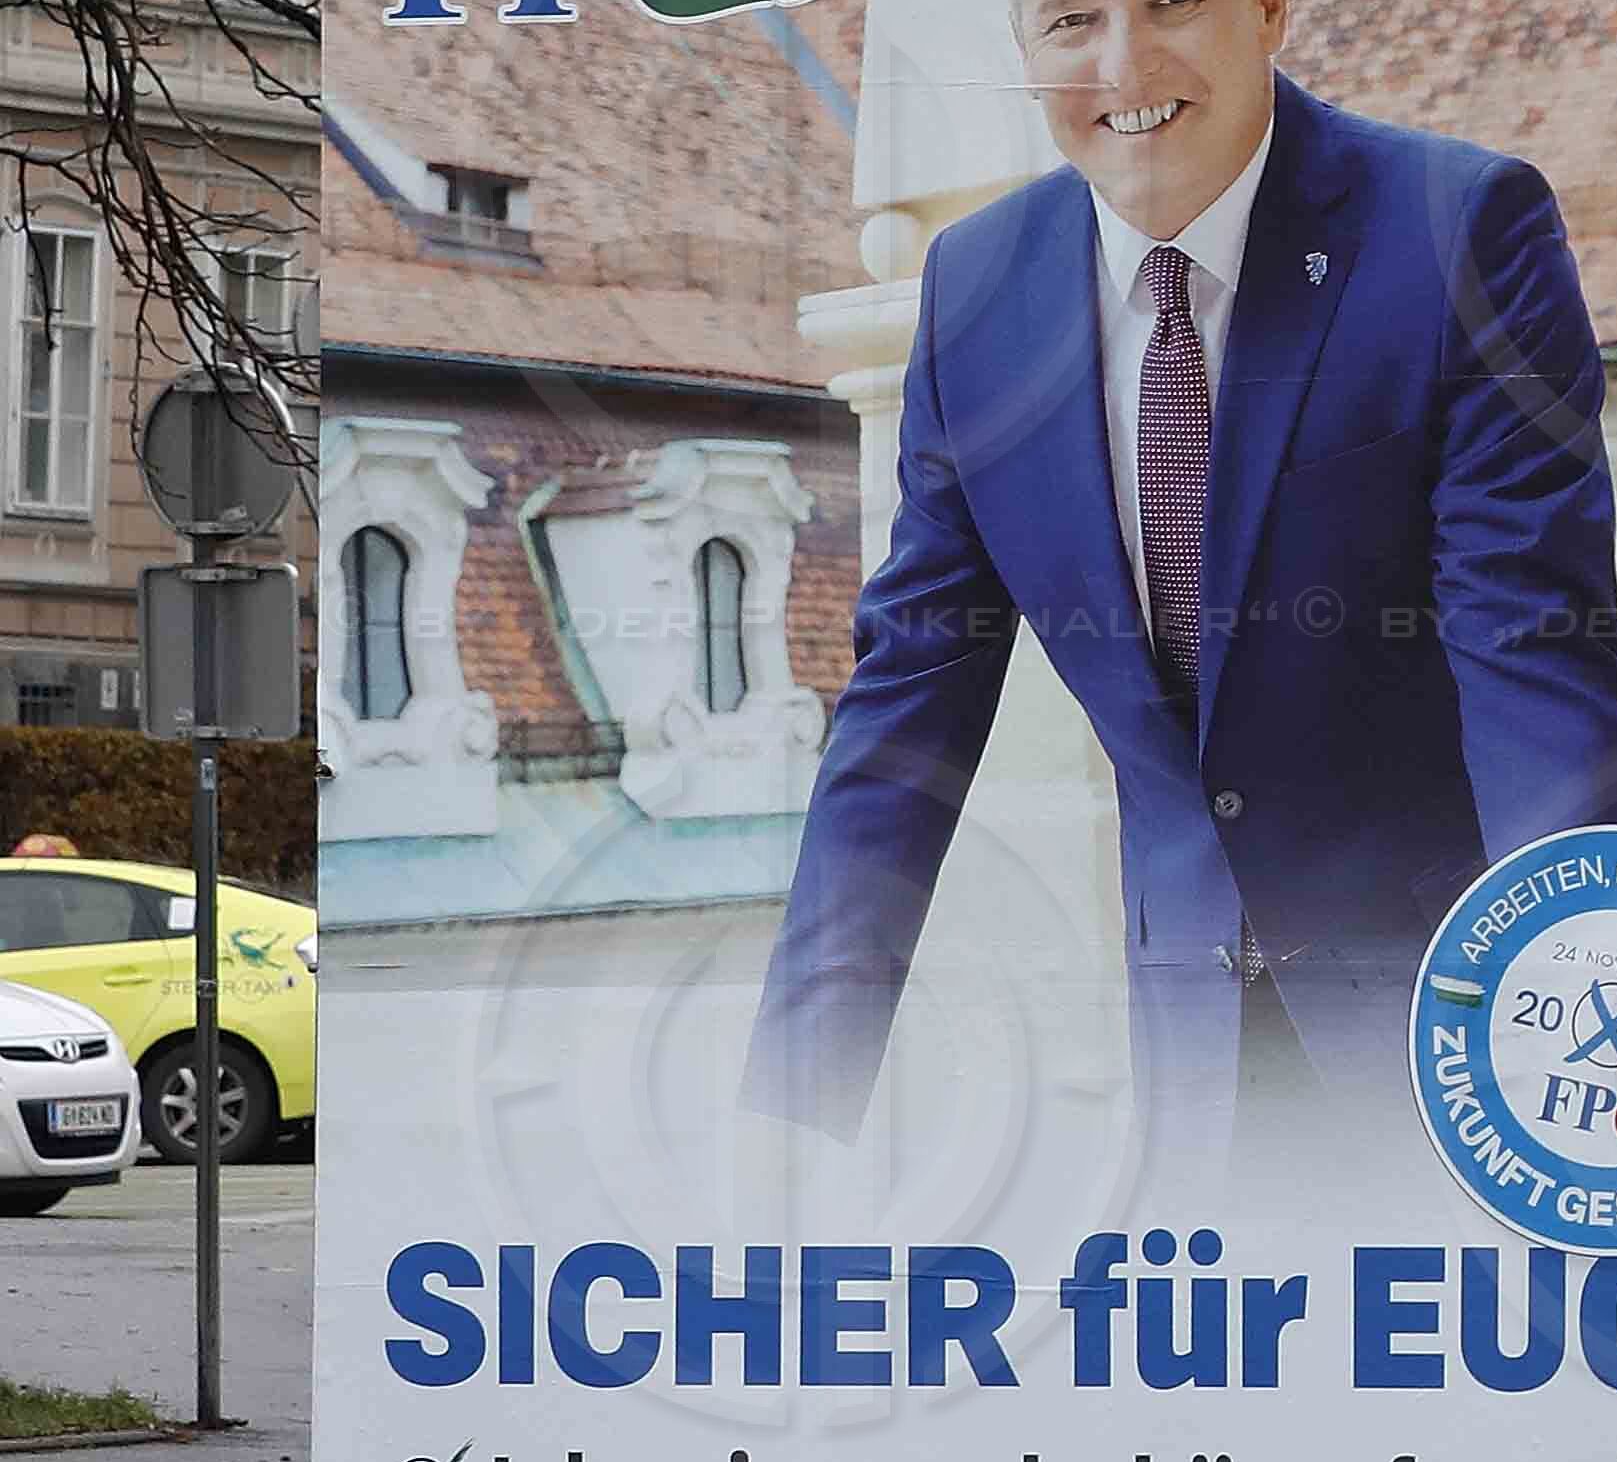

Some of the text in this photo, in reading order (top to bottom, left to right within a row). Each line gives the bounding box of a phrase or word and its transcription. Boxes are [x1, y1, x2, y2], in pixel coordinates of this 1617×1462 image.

[1459, 855, 1610, 965] ARBEITEN,
[1552, 941, 1578, 962] 24
[1510, 989, 1565, 1032] 20
[1433, 1025, 1557, 1208] ZUKUNFT
[384, 1241, 1020, 1390] SICHER
[1059, 1228, 1309, 1392] für
